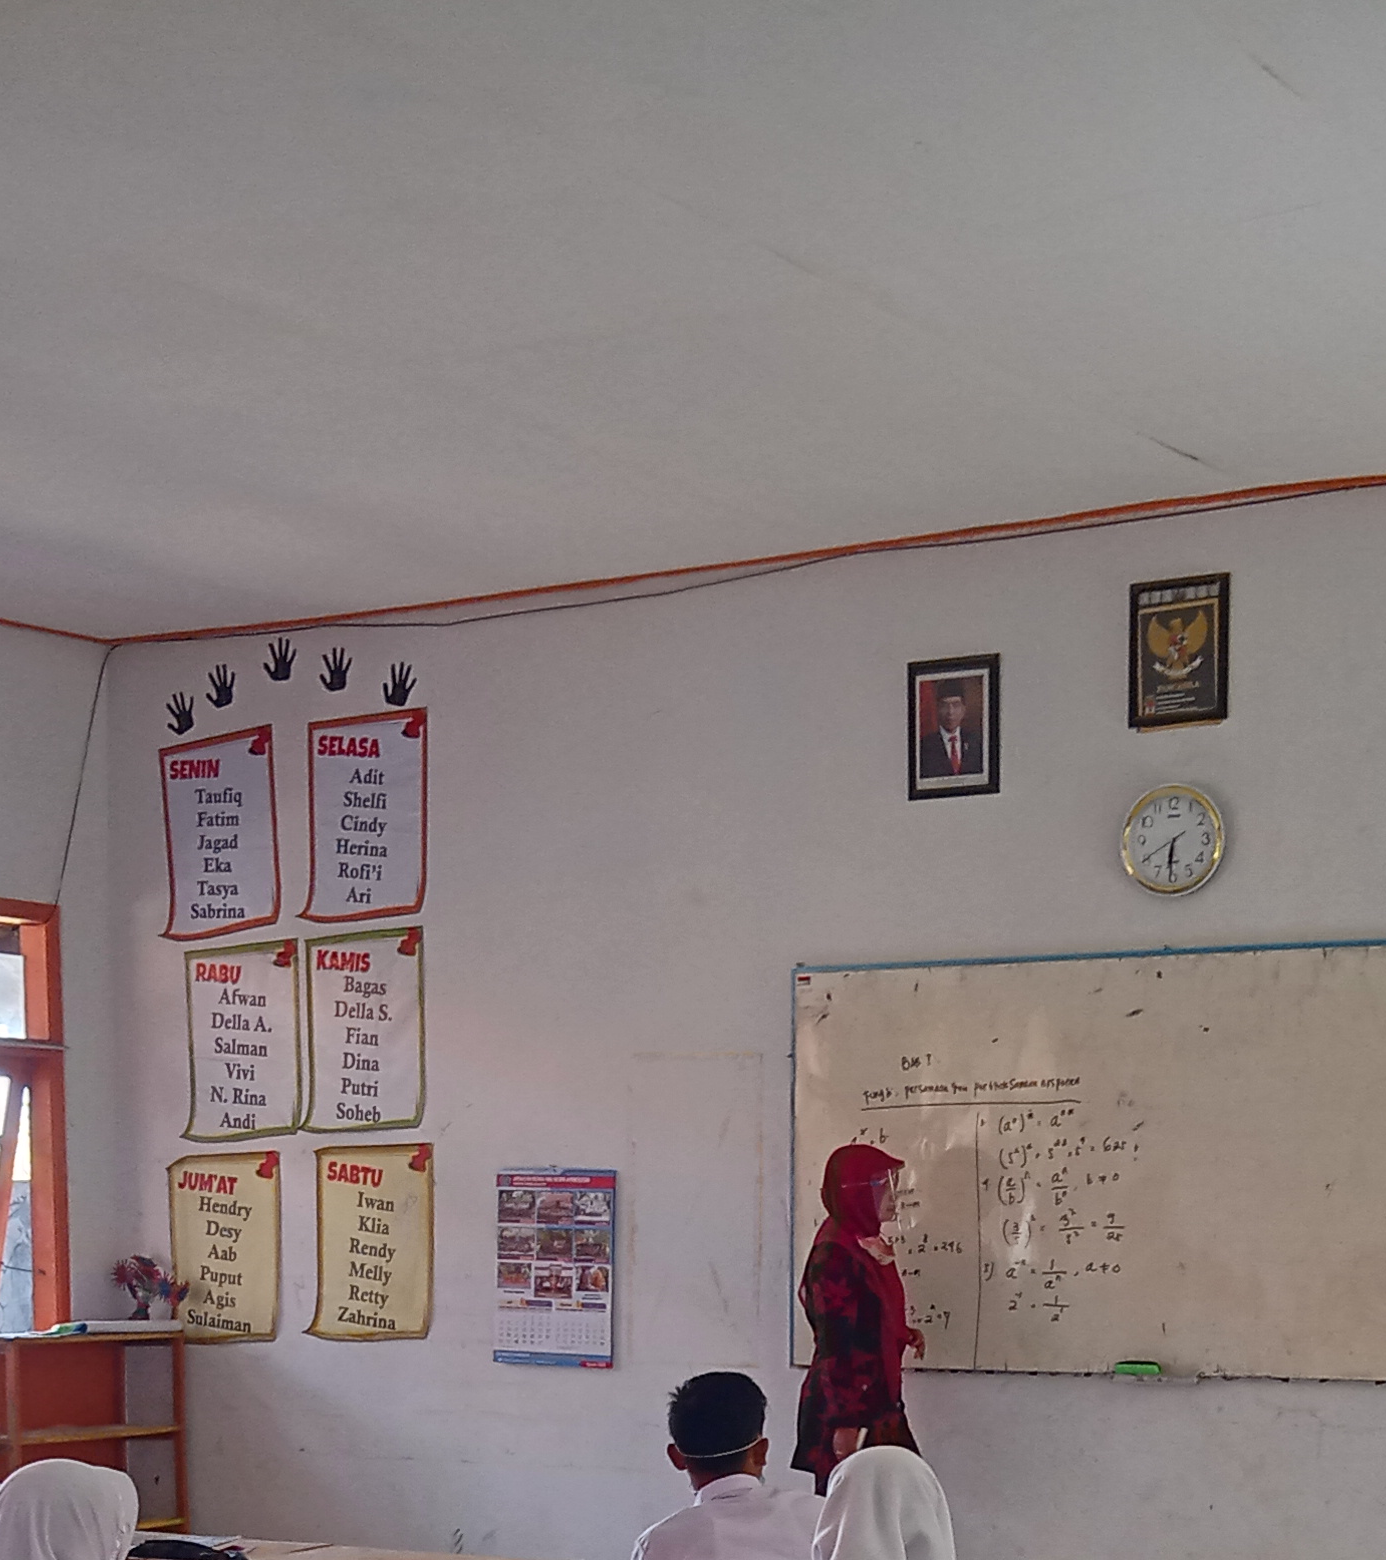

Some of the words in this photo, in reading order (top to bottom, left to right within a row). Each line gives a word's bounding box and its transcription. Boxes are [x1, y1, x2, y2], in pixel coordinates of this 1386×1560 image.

[317, 735, 380, 758] SELASA
[169, 759, 220, 780] SENIN
[349, 768, 385, 786] Adit
[195, 787, 243, 807] Taufiq
[343, 791, 387, 810] Shelfi
[196, 811, 239, 828] Fatim
[340, 815, 387, 837] Cindy
[1197, 812, 1206, 826] 2
[197, 834, 238, 854] Jagad
[335, 838, 387, 858] Herina
[1137, 835, 1146, 846] 9
[1201, 832, 1210, 845] 3
[203, 857, 232, 874] Eka
[1194, 851, 1204, 863] 4
[1154, 865, 1162, 878] 7
[1185, 863, 1193, 878] 5
[197, 881, 238, 898] Tasya
[346, 887, 371, 904] Ari
[190, 903, 245, 920] Sabrina
[316, 949, 371, 973] KAMIS
[195, 962, 241, 984] RABU
[343, 976, 387, 998] Bagas
[217, 988, 267, 1007] Afwan
[334, 1000, 374, 1021] Della
[378, 1004, 393, 1022] S.
[211, 1012, 250, 1032] Della
[254, 1016, 273, 1033] A.
[345, 1027, 379, 1046] Fian
[214, 1037, 268, 1057] Salman
[225, 1062, 255, 1081] Vivi
[342, 1052, 380, 1072] Dina
[210, 1086, 228, 1103] N.
[232, 1087, 267, 1107] Rina
[341, 1077, 379, 1098] Putri
[219, 1111, 256, 1130] Andi
[335, 1102, 381, 1123] Soheb
[178, 1170, 238, 1195] JUM'AT
[327, 1161, 383, 1187] SABTU
[198, 1196, 252, 1221] Hendry
[357, 1191, 395, 1212] Iwan
[205, 1220, 242, 1243] Desy
[207, 1243, 237, 1262] Aab
[349, 1237, 396, 1262] Rendy
[199, 1265, 243, 1288] Puput
[348, 1262, 392, 1284] Melly
[203, 1289, 236, 1310] Agis
[349, 1284, 389, 1309] Retty
[187, 1309, 251, 1334] Sulaiman
[338, 1306, 396, 1331] Zahrina
